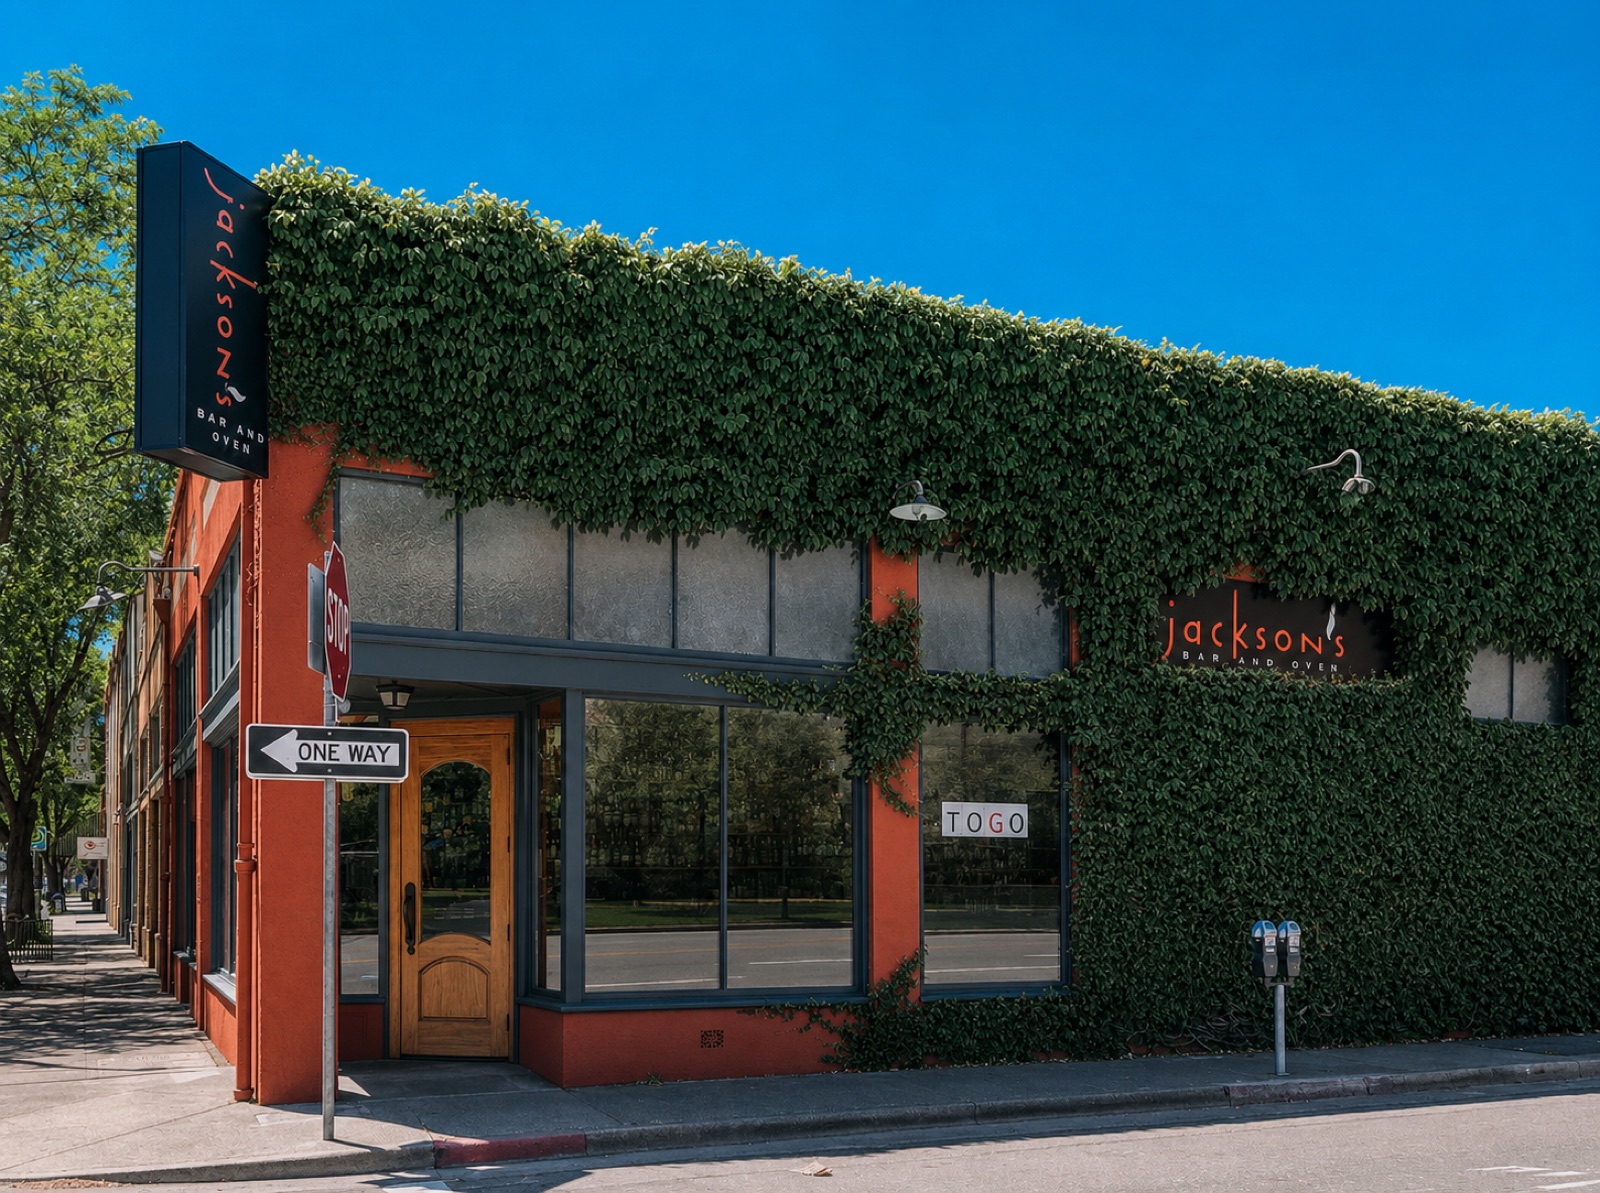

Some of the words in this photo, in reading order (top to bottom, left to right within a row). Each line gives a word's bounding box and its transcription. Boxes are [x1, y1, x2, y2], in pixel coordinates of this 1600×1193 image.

[196, 407, 227, 428] BAR
[236, 425, 264, 444] AND
[212, 432, 250, 454] OVEN
[327, 588, 349, 655] STOP
[1182, 650, 1220, 663] BAR
[1238, 657, 1274, 668] AND
[1291, 660, 1338, 672] OVEN
[299, 742, 340, 762] ONE
[348, 744, 391, 763] WAY
